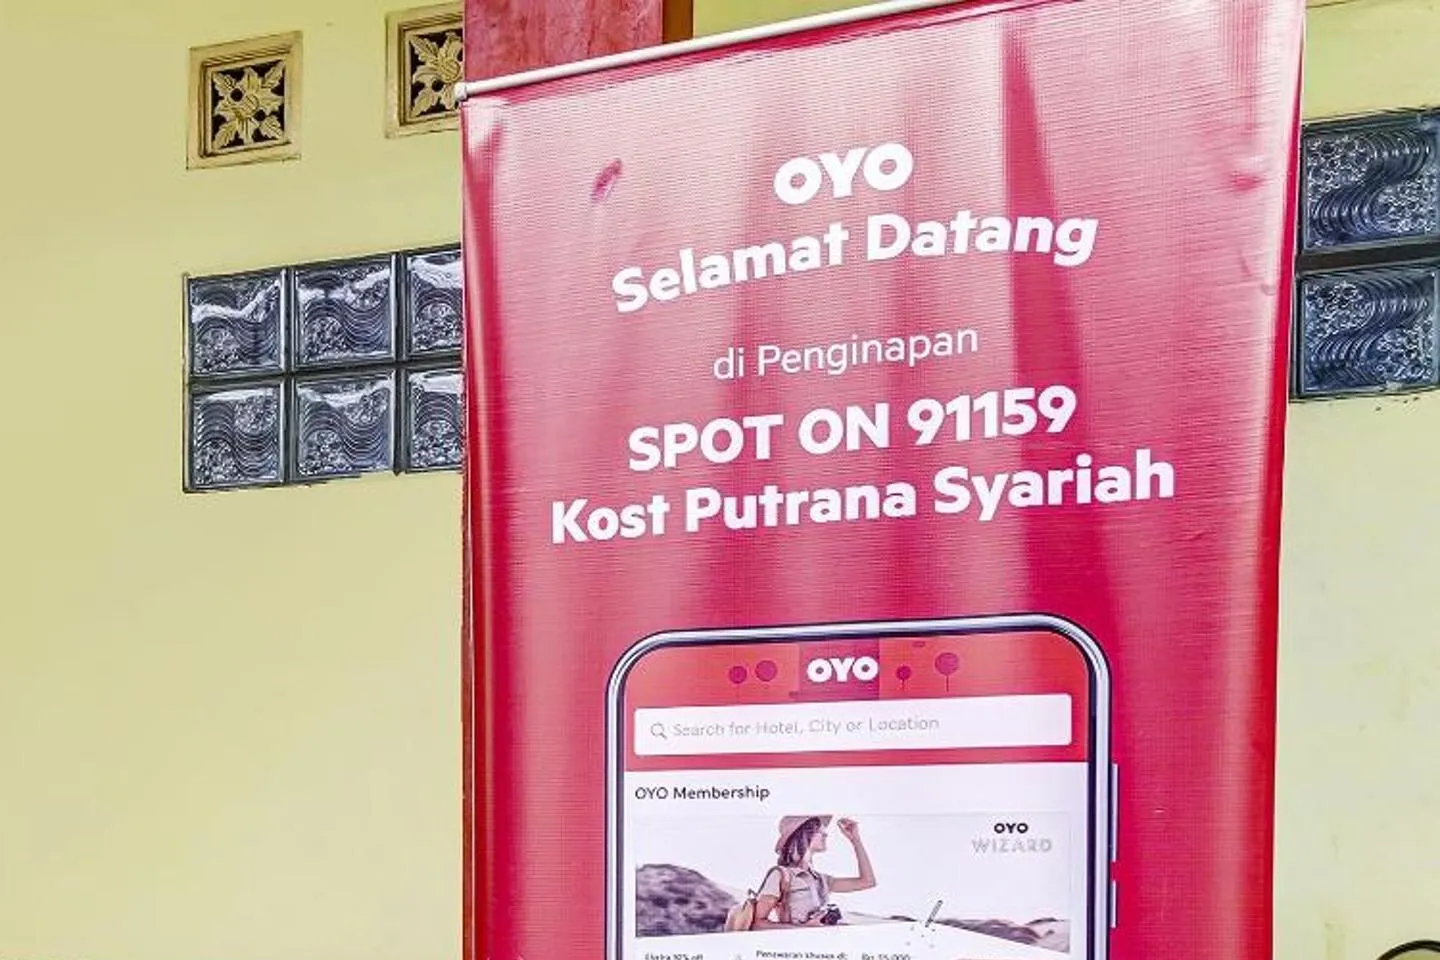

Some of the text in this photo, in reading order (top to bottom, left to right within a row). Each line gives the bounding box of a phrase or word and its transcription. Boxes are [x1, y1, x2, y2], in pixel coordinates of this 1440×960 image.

[773, 142, 913, 204] OYO
[612, 212, 1099, 314] Selamat Datang
[713, 325, 979, 380] di Penginapan
[628, 385, 1078, 473] SPOT ON 91159
[551, 448, 1174, 544] Kost Putrana Syariah
[807, 655, 879, 683] OYO
[673, 717, 939, 737] Search for Hotel, City or Location
[635, 784, 770, 800] OYO Membership
[972, 838, 1053, 853] WIZARD
[993, 822, 1028, 834] OYO
